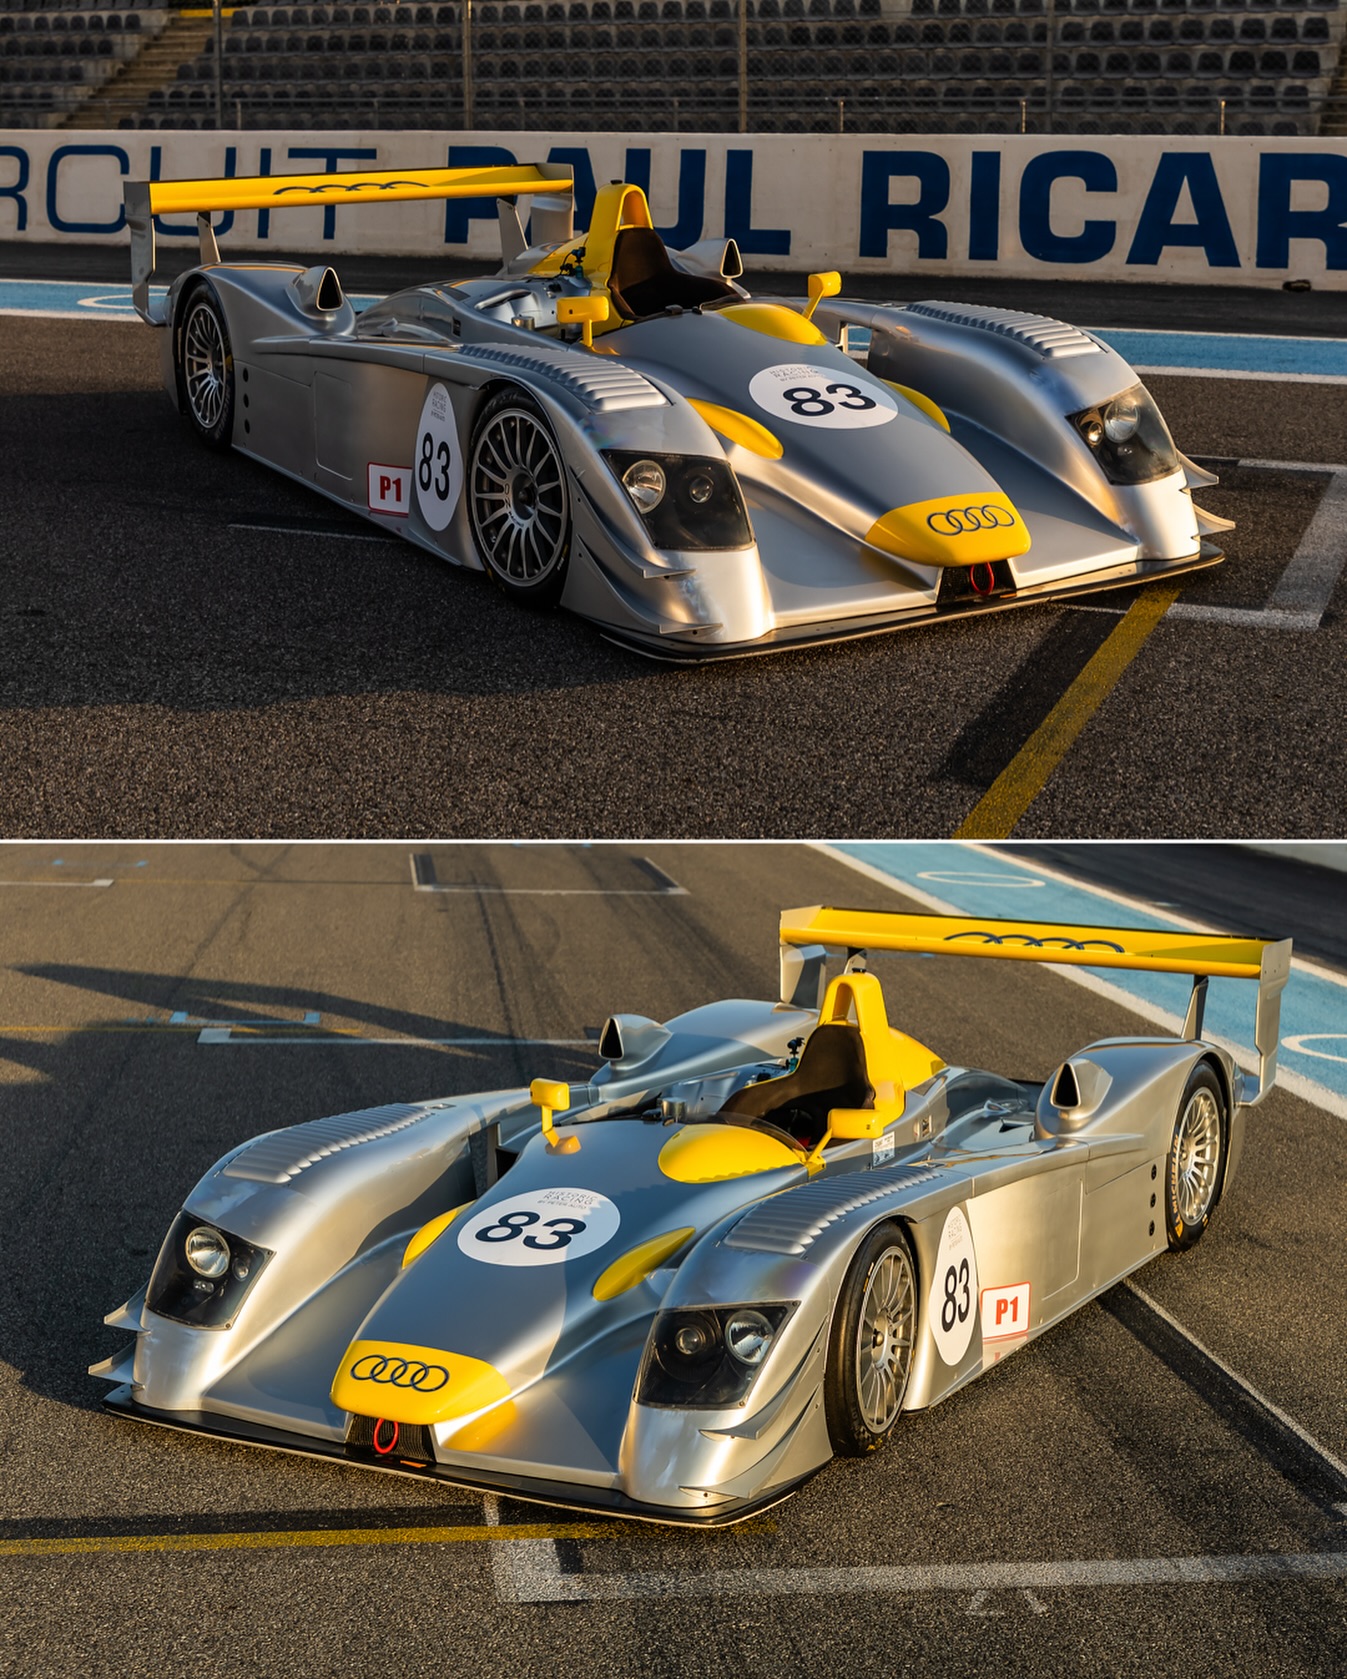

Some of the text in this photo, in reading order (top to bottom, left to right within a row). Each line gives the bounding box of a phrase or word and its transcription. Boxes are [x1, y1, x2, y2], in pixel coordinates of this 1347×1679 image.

[444, 145, 791, 256] PAUL
[859, 150, 1347, 271] RICAR
[783, 383, 877, 417] 83
[418, 432, 451, 501] 83
[379, 475, 402, 502] P1
[543, 1194, 593, 1206] RACING
[548, 1191, 597, 1201] HISTORIC
[475, 1211, 587, 1250] 83
[941, 1257, 971, 1333] 83
[995, 1296, 1019, 1325] P1
